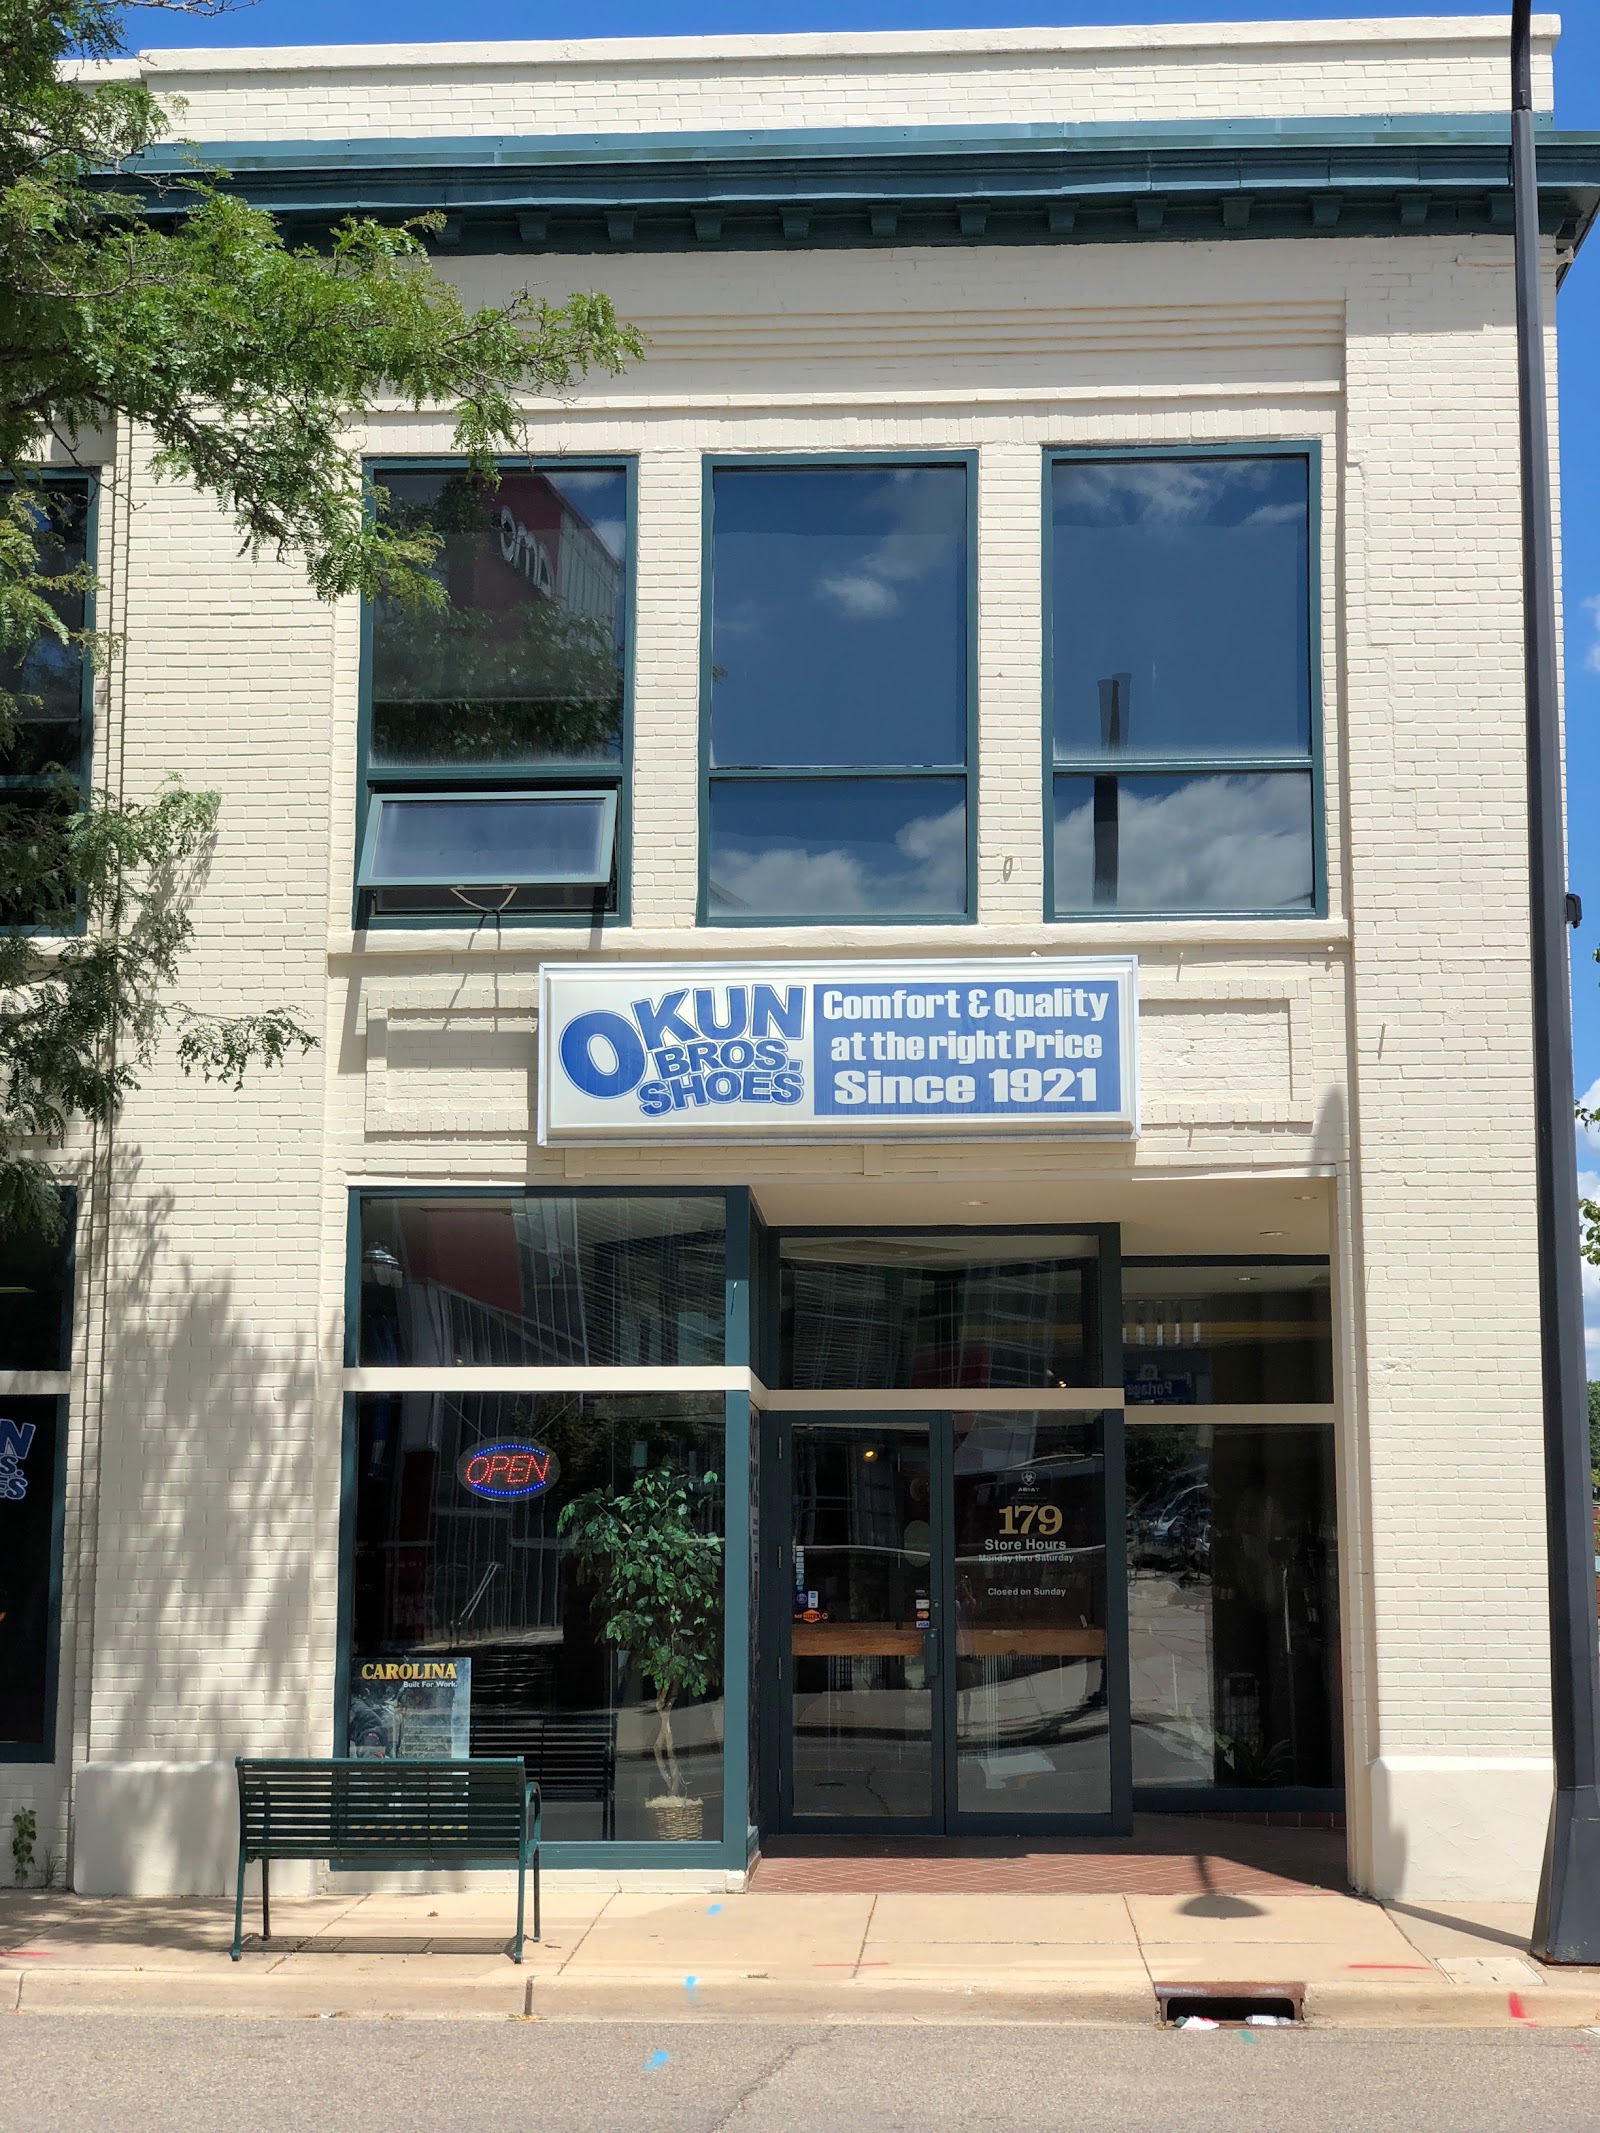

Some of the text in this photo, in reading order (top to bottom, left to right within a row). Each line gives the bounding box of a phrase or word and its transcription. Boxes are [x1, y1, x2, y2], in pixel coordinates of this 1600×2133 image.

[823, 988, 1109, 1021] Comfort & Quality
[558, 984, 806, 1100] OKUN
[831, 1029, 1102, 1064] at the right Price
[652, 1038, 803, 1081] BROS.
[637, 1070, 804, 1117] SHOES
[834, 1068, 1097, 1105] Since 1921
[466, 1454, 550, 1484] OPEN
[998, 1505, 1063, 1535] 179
[979, 1554, 1074, 1563] Monday thru Saturday
[985, 1539, 1067, 1550] Store Hours
[987, 1588, 1018, 1596] Closed
[1034, 1588, 1066, 1597] Sunday
[361, 1663, 457, 1680] CAROLINA
